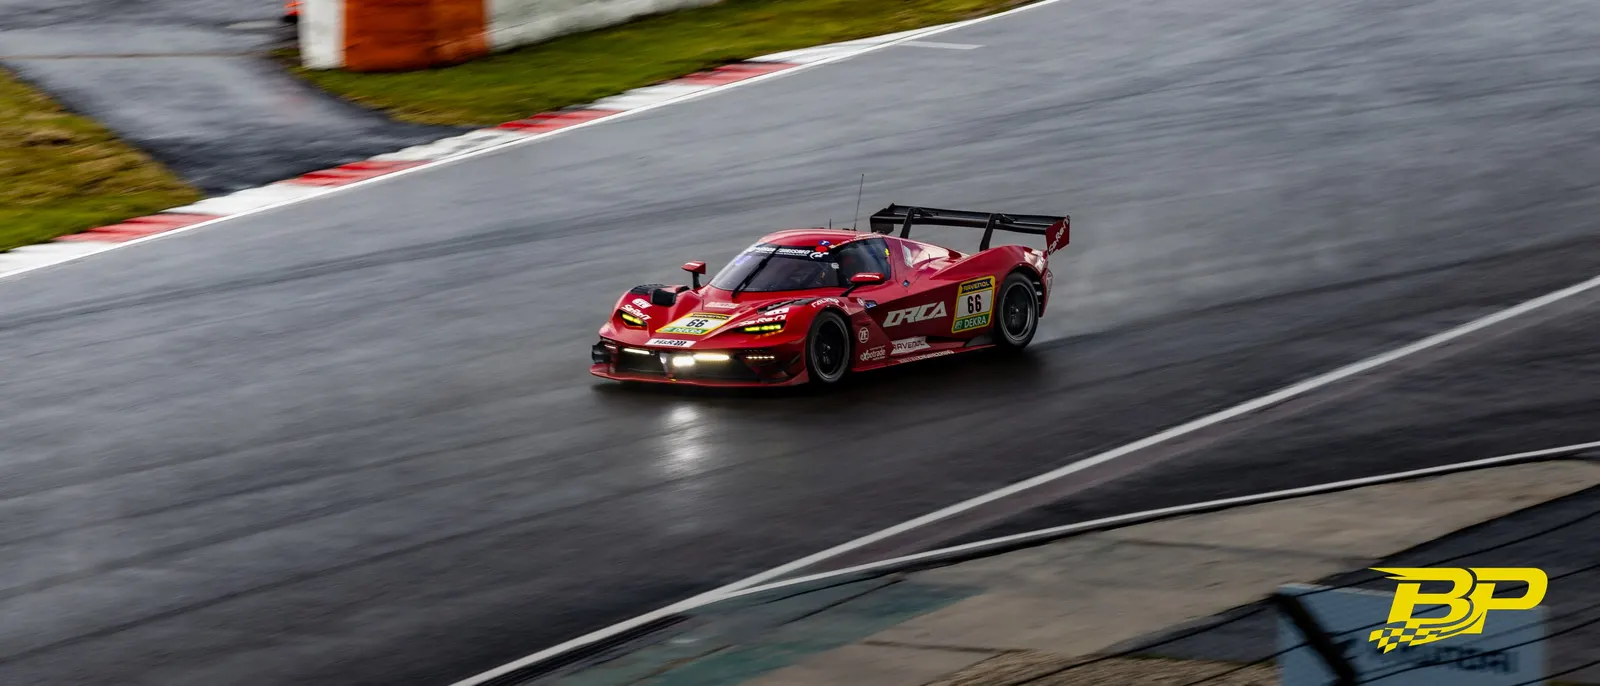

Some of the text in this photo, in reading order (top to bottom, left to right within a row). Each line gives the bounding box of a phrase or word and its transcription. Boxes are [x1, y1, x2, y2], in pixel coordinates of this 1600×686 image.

[967, 294, 981, 314] 66
[882, 301, 947, 328] ORCA
[964, 316, 987, 328] DEKRA
[686, 319, 708, 328] 66
